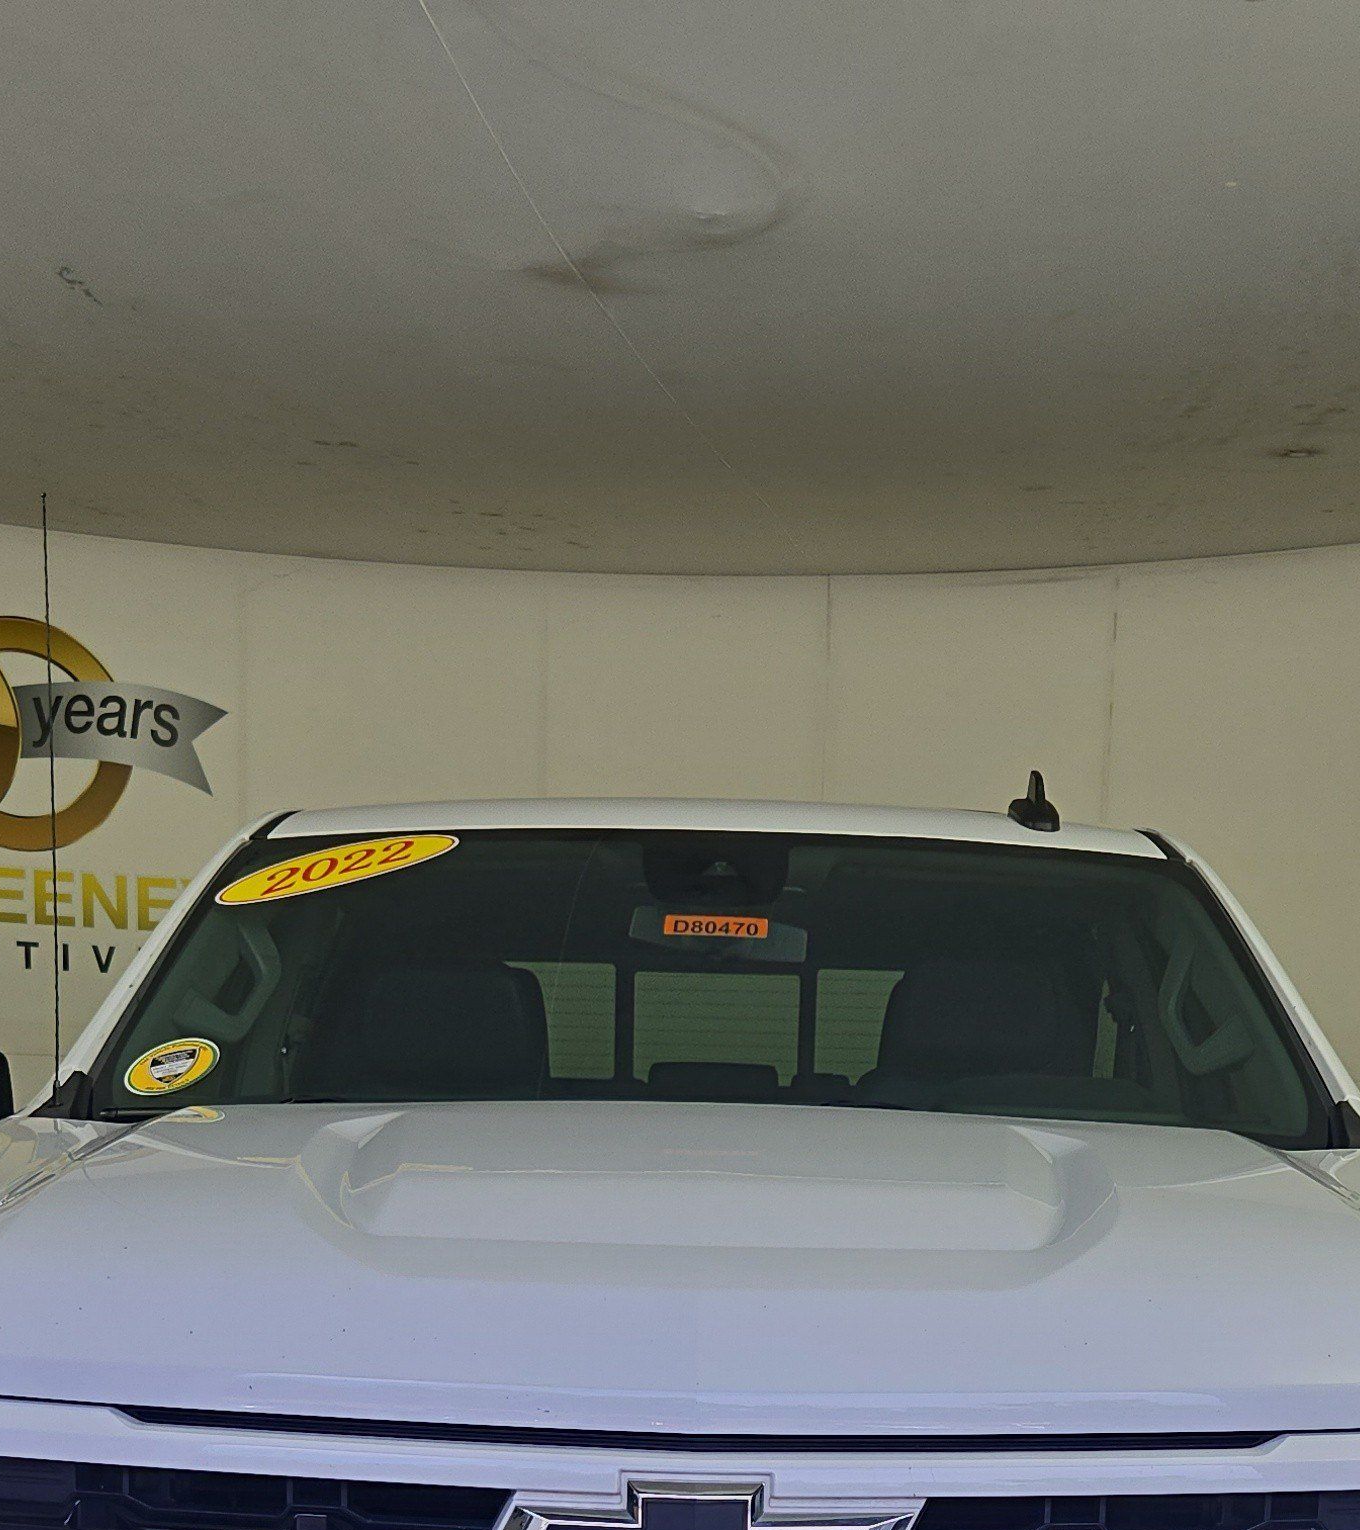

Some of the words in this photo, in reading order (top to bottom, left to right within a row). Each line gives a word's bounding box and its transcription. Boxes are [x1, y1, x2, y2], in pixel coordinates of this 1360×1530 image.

[31, 692, 181, 749] years
[260, 840, 415, 896] 2022
[672, 919, 759, 936] D80470
